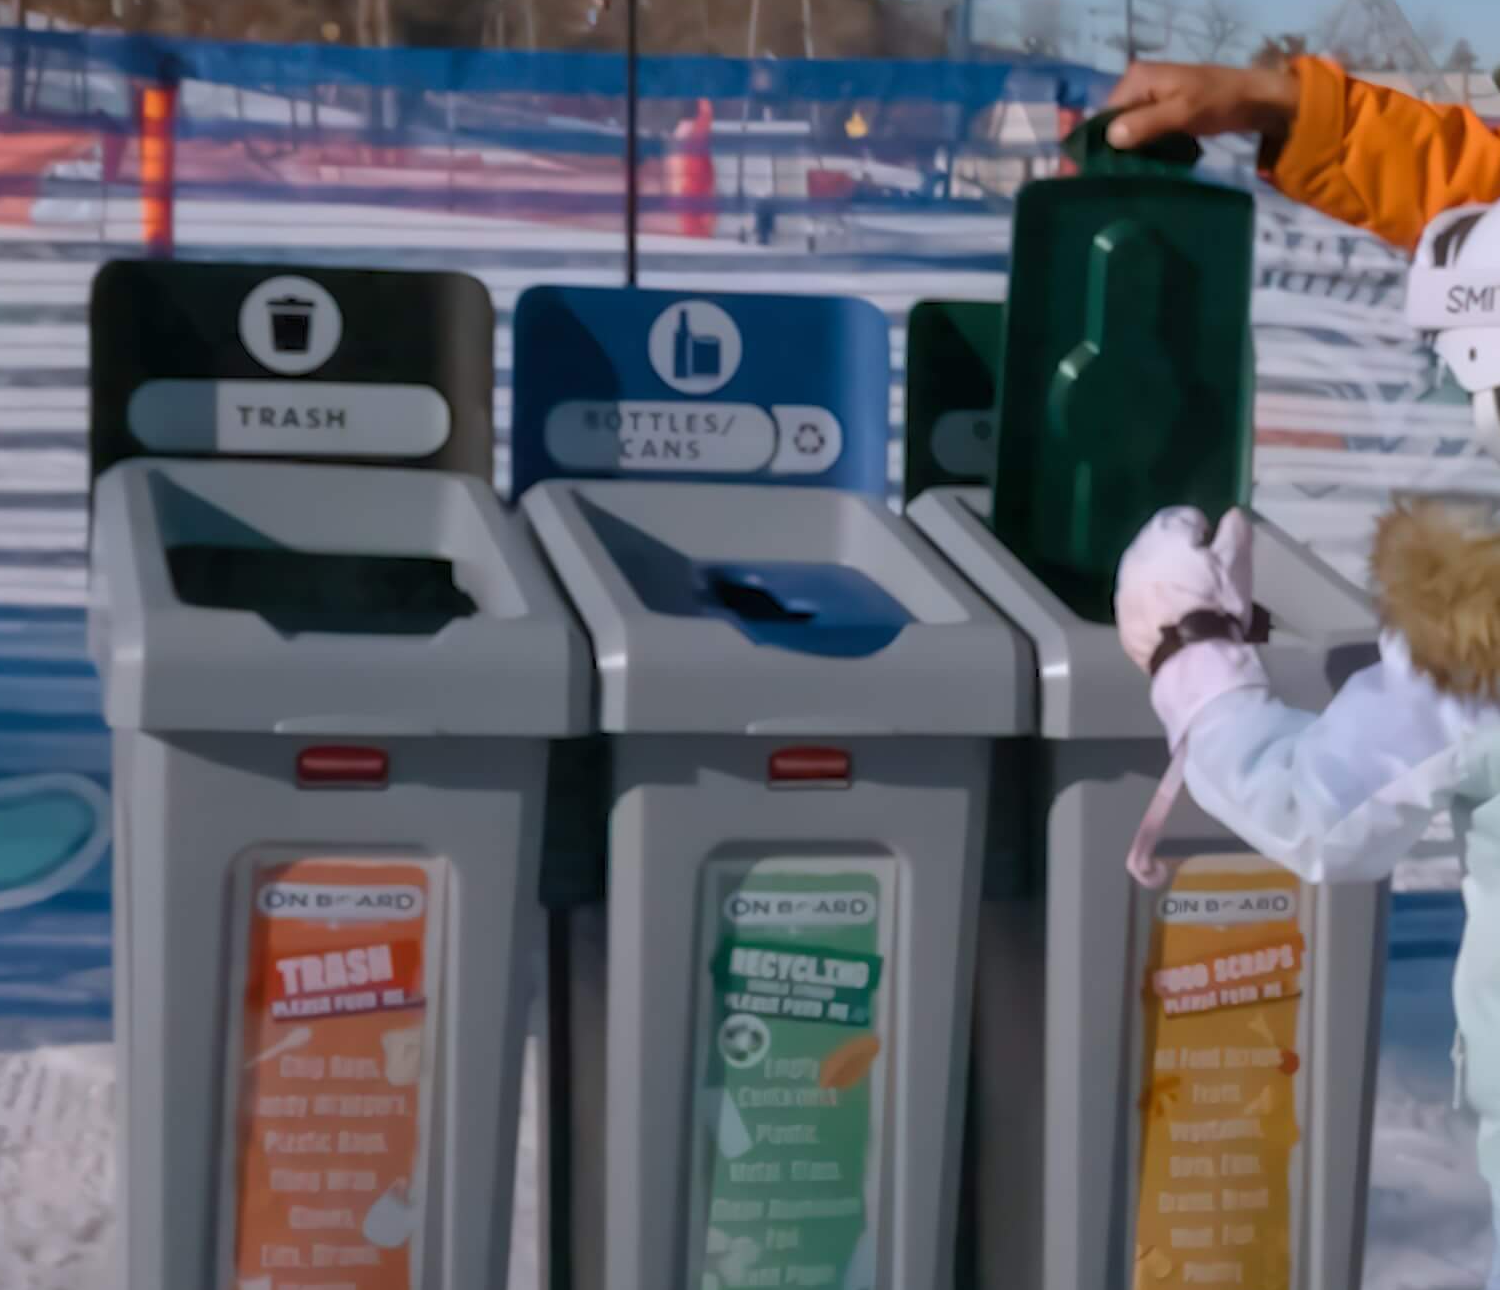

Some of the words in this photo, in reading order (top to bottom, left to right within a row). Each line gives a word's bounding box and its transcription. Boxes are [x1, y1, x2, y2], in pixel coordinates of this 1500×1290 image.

[235, 405, 347, 429] TRASH
[620, 438, 703, 460] CANS
[264, 891, 309, 909] ON
[731, 897, 771, 917] ON
[1161, 897, 1199, 916] ON
[275, 943, 394, 996] TRASH
[729, 946, 870, 990] RECYCLING
[1213, 943, 1294, 982] SCRAPS
